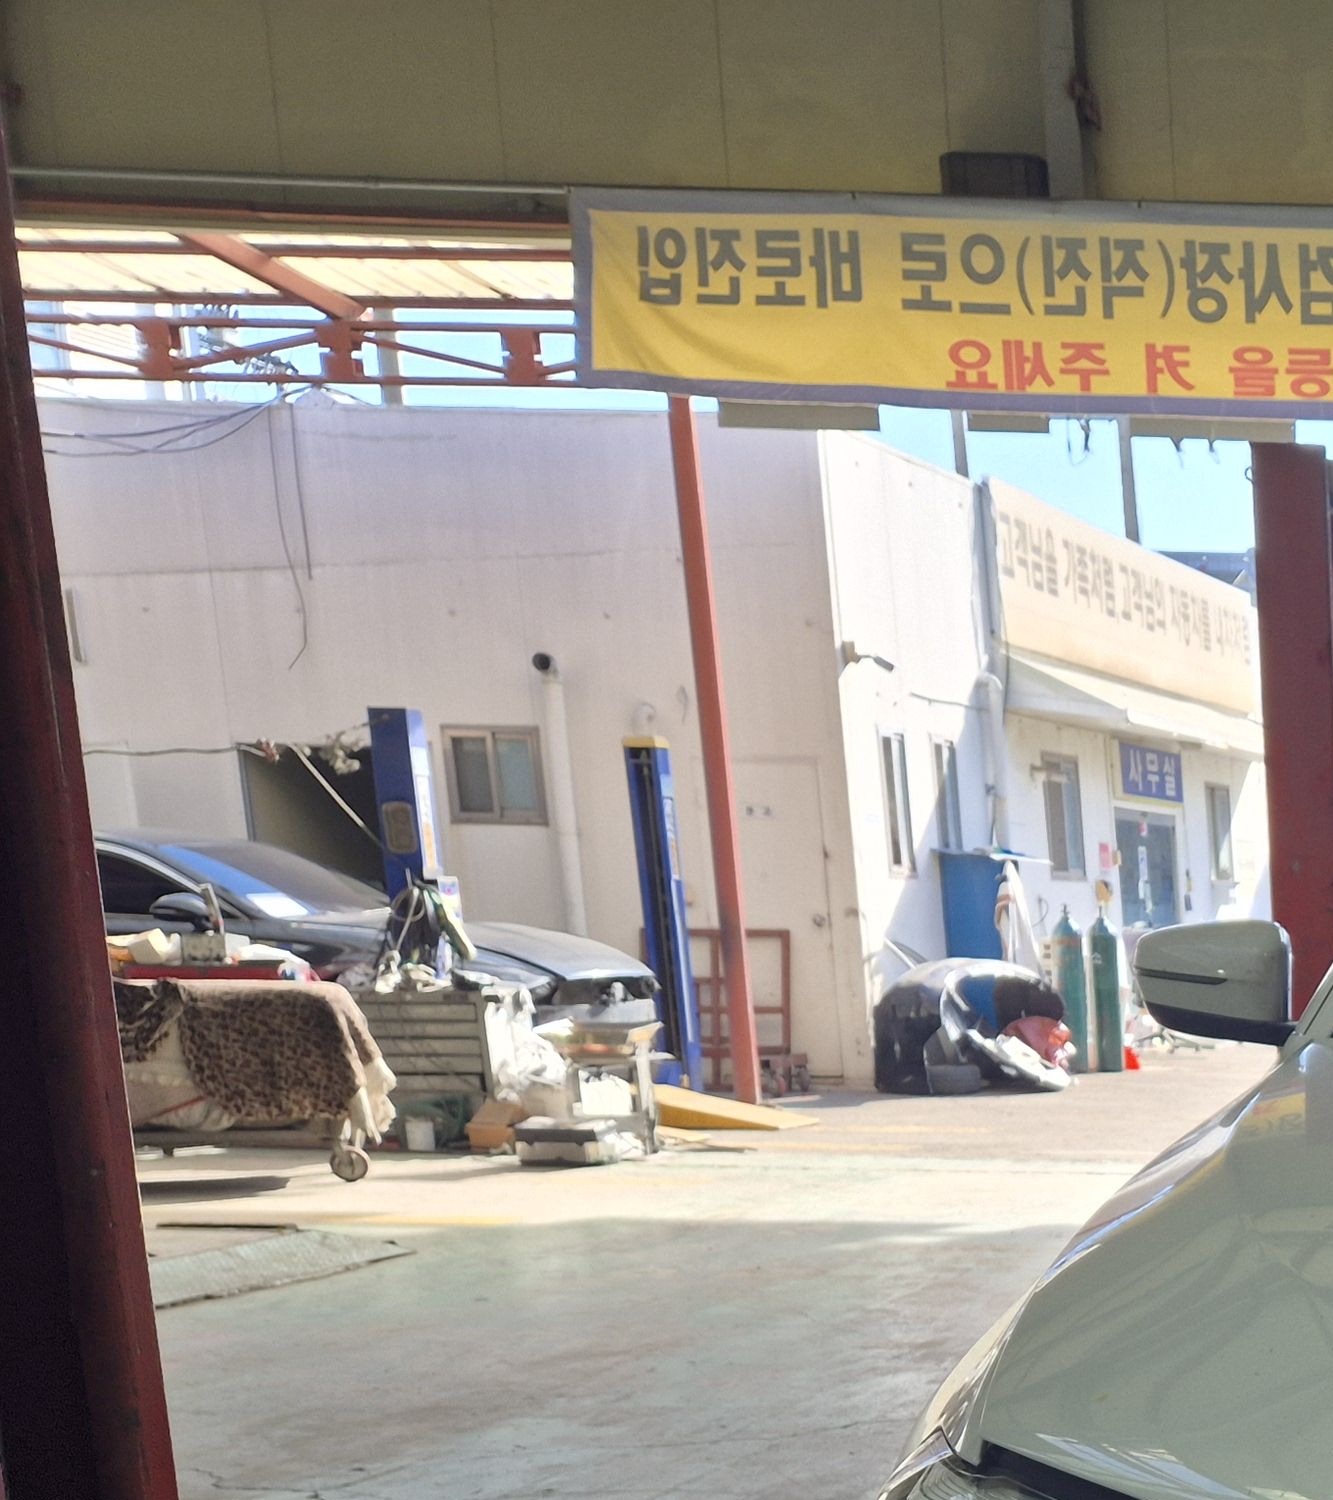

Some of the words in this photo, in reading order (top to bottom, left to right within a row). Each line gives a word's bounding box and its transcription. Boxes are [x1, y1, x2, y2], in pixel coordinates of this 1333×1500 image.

[1000, 511, 1059, 598] 고객님을
[1119, 562, 1166, 636] 고객님의
[1169, 584, 1212, 652] 자동차를
[1128, 749, 1177, 797] 사무실
